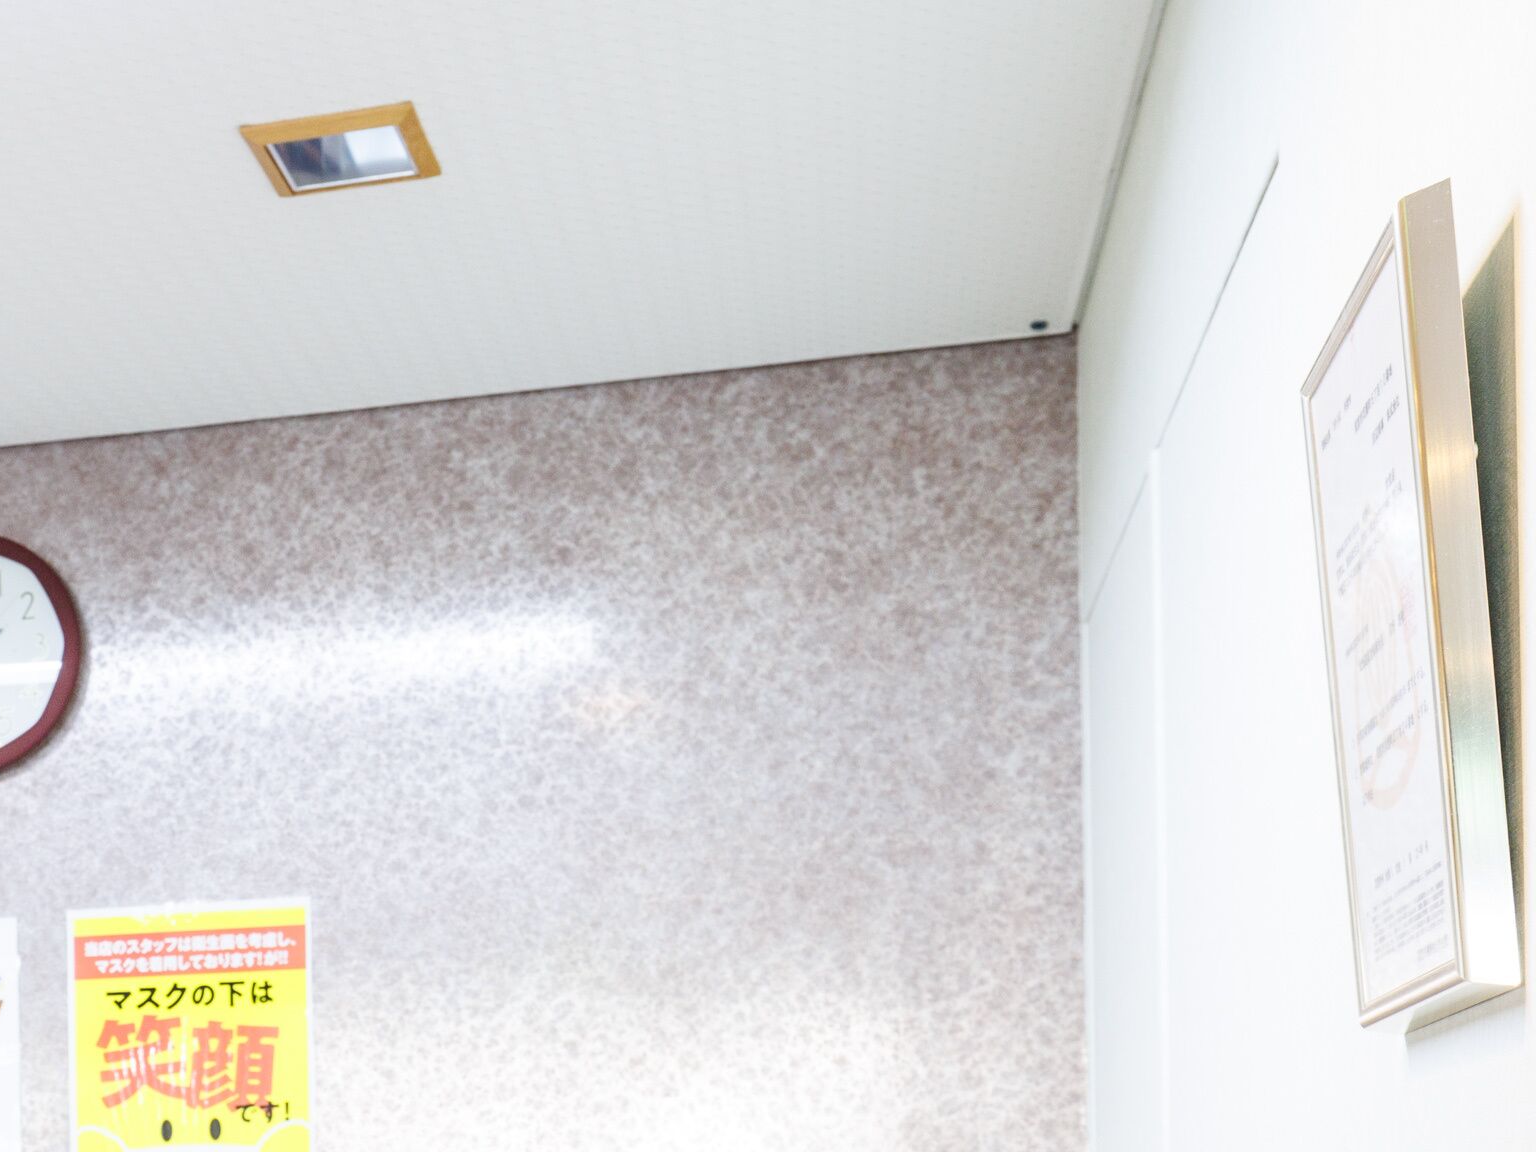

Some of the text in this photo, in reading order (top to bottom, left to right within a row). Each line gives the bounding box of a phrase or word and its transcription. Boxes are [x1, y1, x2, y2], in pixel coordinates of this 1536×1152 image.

[19, 591, 36, 620] 2
[106, 980, 274, 1010] マスクの下は
[96, 1014, 280, 1112] 笑顔
[236, 1101, 290, 1123] です!
